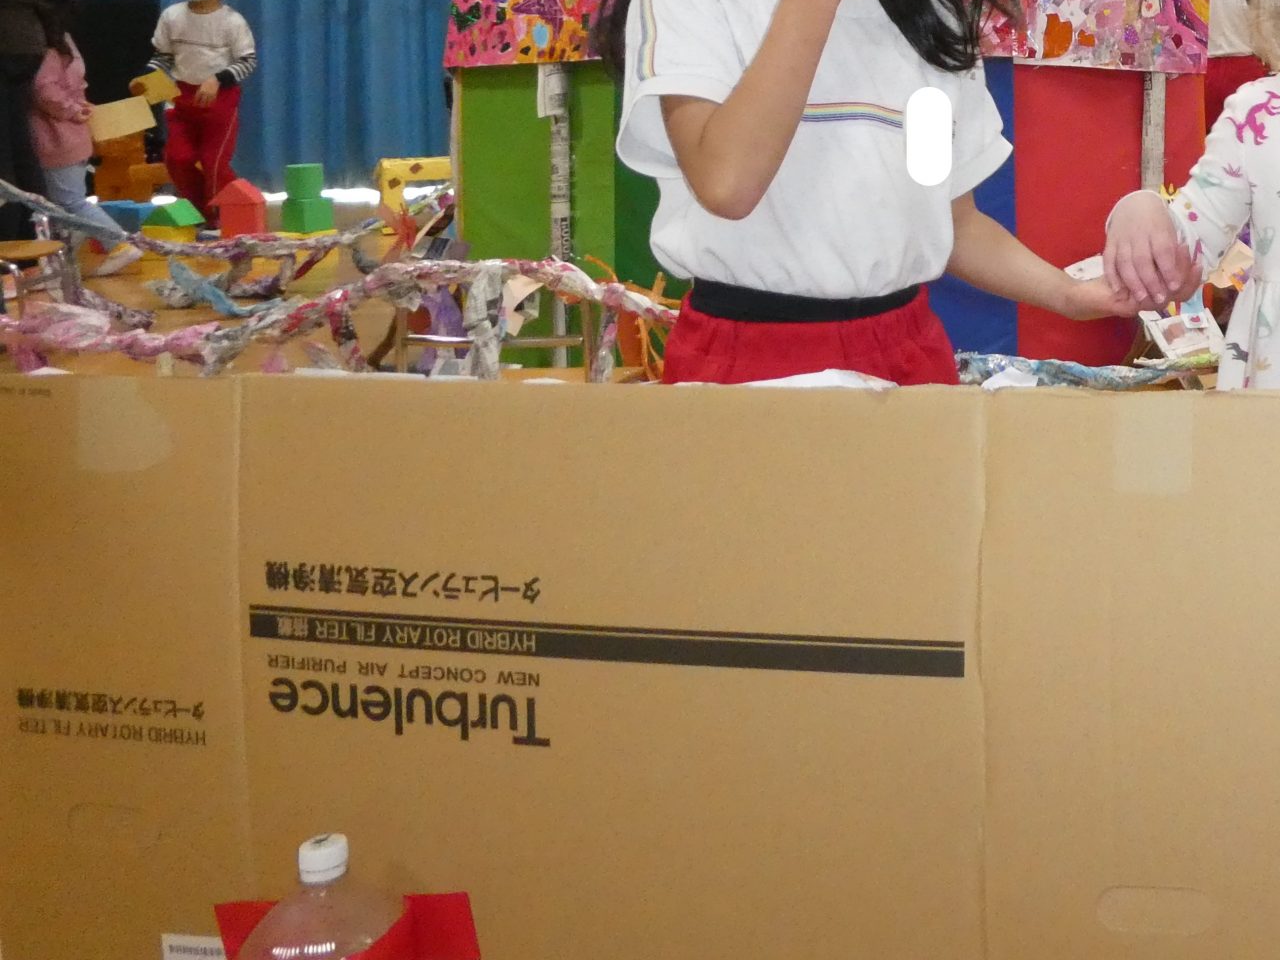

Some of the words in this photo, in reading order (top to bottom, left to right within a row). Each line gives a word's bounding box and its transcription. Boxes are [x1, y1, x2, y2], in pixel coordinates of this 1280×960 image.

[265, 561, 541, 604] タービュランス空気清浄機
[315, 620, 376, 642] FILTER
[381, 624, 461, 647] ROTARY
[467, 629, 536, 652] HYBRID
[266, 653, 348, 674] PURIFIER
[357, 661, 388, 676] AIR
[397, 664, 487, 684] CONCEPT
[496, 671, 540, 687] NEW
[268, 677, 551, 748] Turbulence
[18, 719, 71, 737] FILTER
[75, 722, 144, 742] ROTARY
[147, 726, 207, 746] HYBRID
